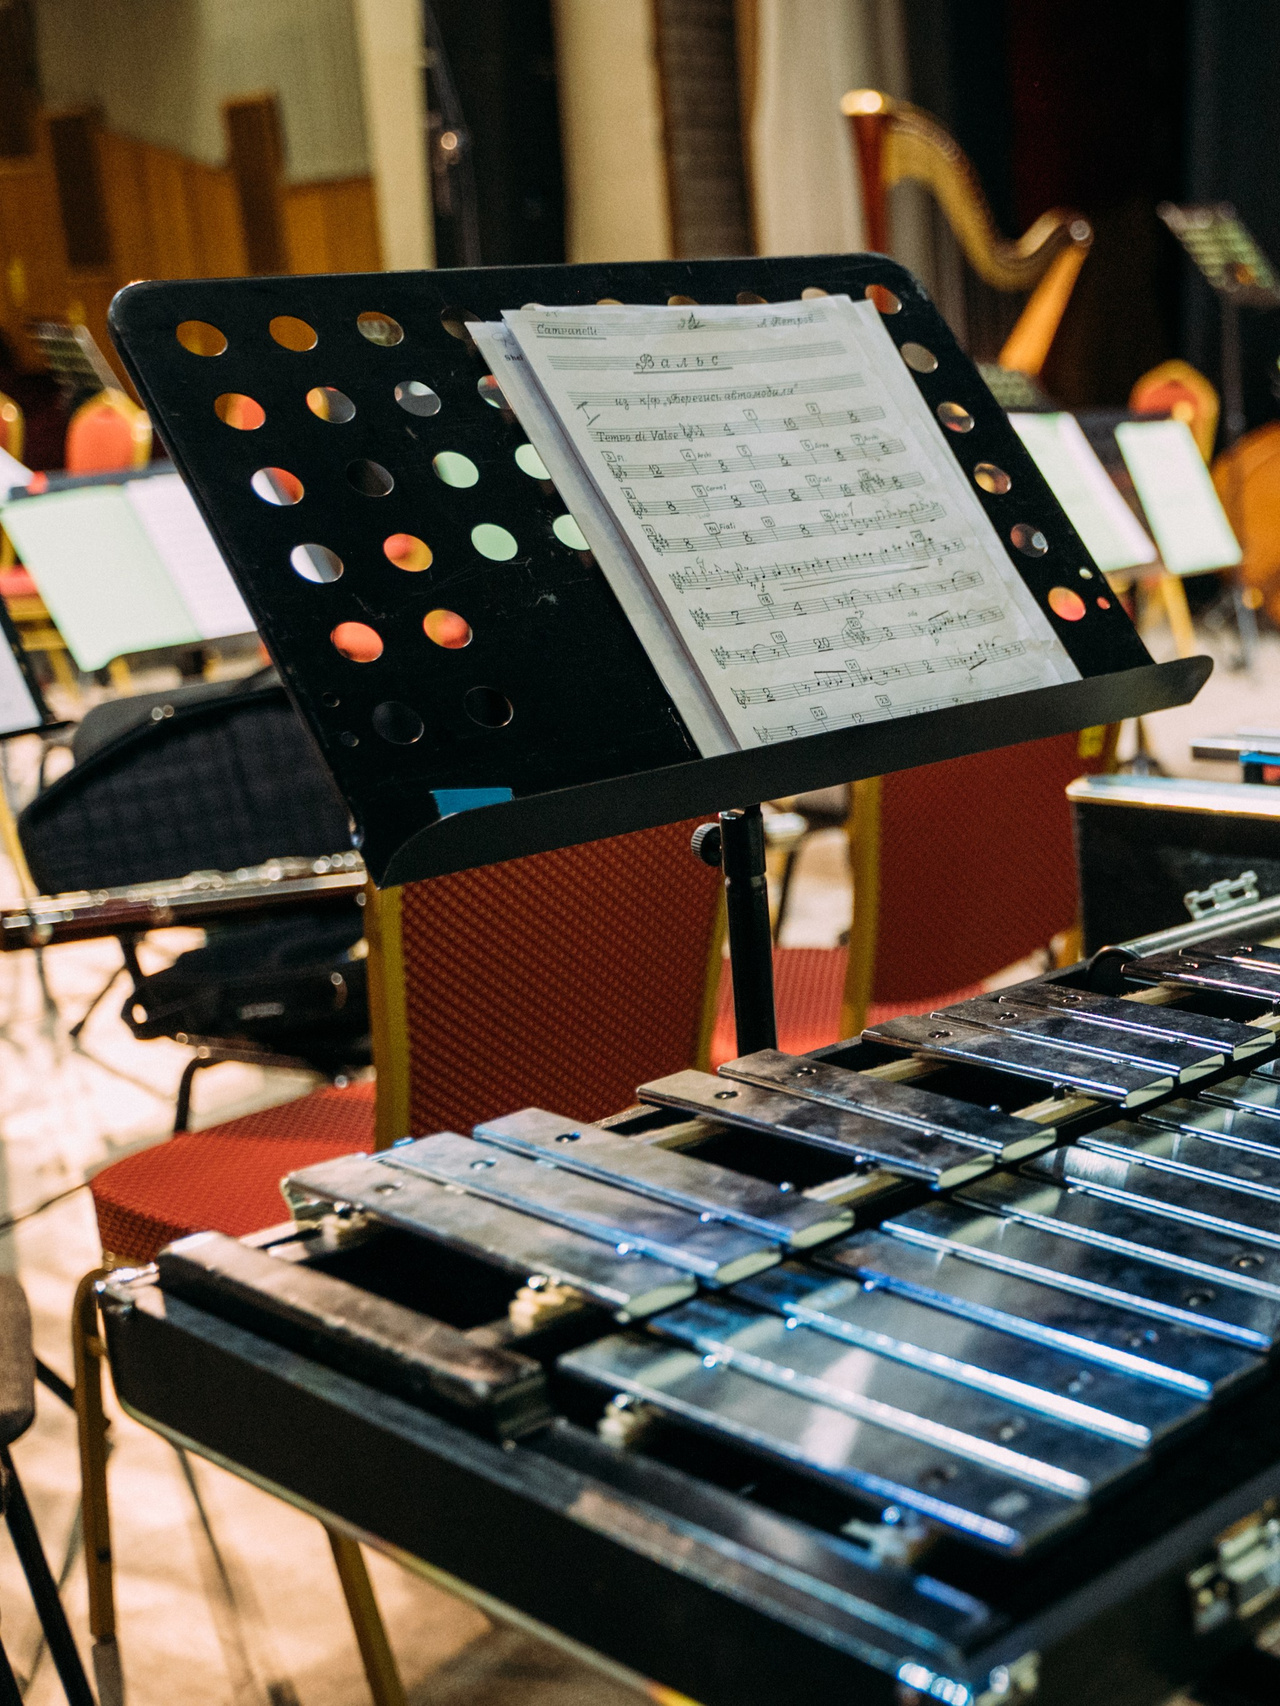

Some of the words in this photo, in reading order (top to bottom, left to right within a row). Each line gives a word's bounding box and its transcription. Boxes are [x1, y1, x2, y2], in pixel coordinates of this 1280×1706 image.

[635, 353, 719, 371] Вальс
[596, 431, 631, 443] Tempo
[634, 431, 646, 442] di
[649, 429, 679, 441] Valse
[719, 521, 736, 530] Fiati
[813, 636, 831, 650] 20
